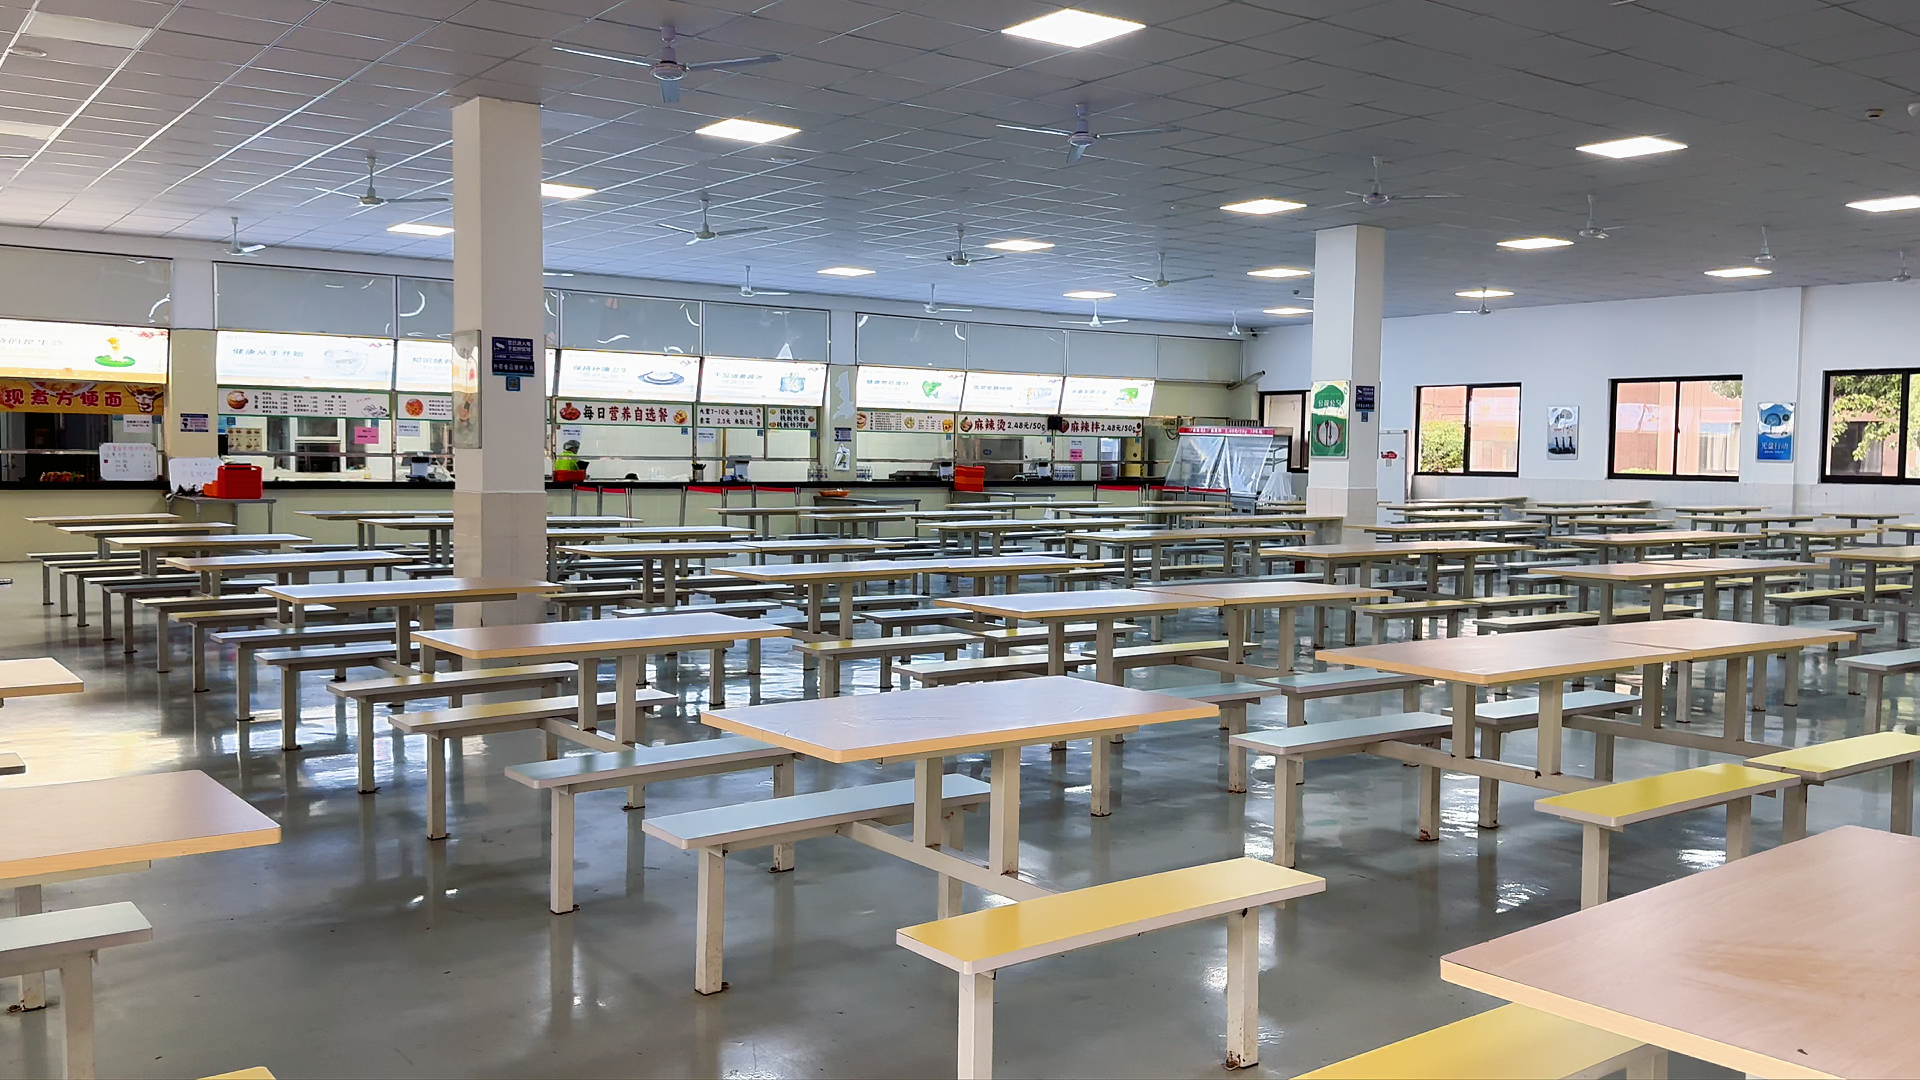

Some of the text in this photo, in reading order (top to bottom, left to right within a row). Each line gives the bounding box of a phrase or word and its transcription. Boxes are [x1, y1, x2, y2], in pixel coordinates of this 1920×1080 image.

[4, 388, 122, 407] 现煮方便面
[583, 404, 668, 423] 每日营养自选餐
